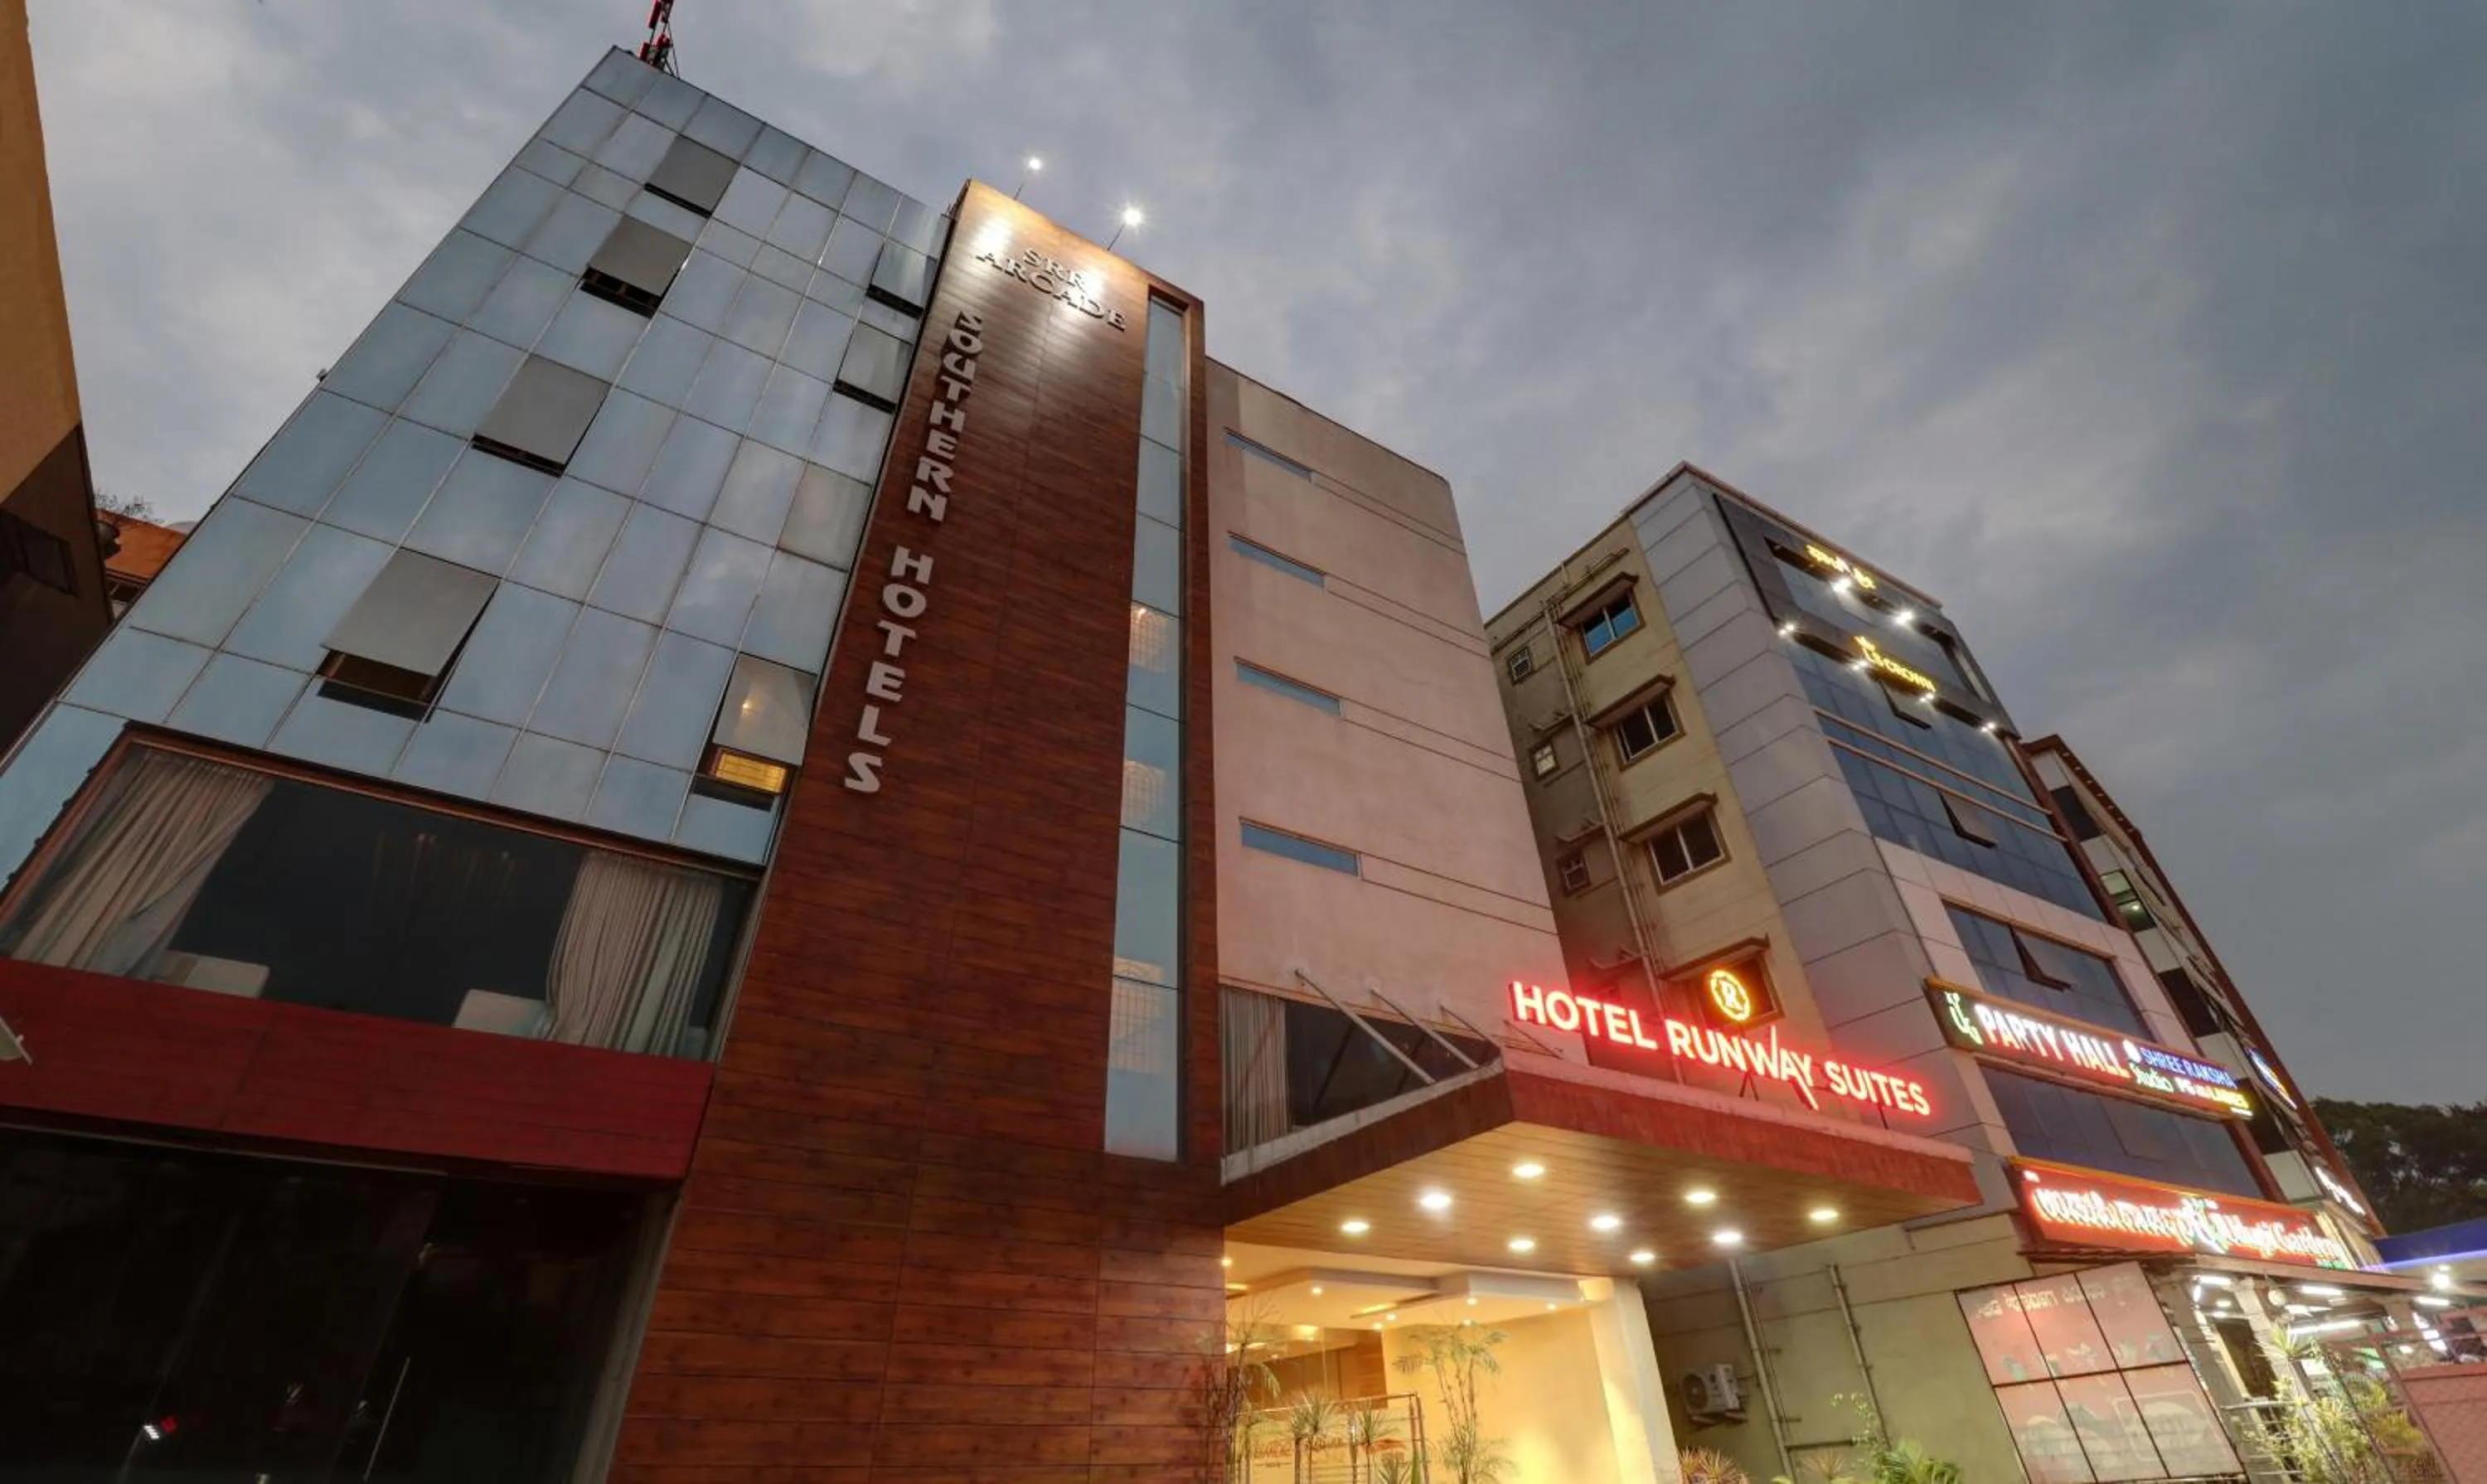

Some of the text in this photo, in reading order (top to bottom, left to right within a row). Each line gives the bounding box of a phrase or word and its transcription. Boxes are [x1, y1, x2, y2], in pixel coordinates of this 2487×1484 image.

[975, 251, 1127, 332] ARCADE
[844, 310, 983, 795] SOUTHERN HOTELS
[1509, 981, 1932, 1116] HOTEL RUNWAY SUITES
[1974, 1003, 2064, 1061] PARTY
[2060, 1029, 2131, 1079] HALL
[2140, 1046, 2187, 1075] SHREE
